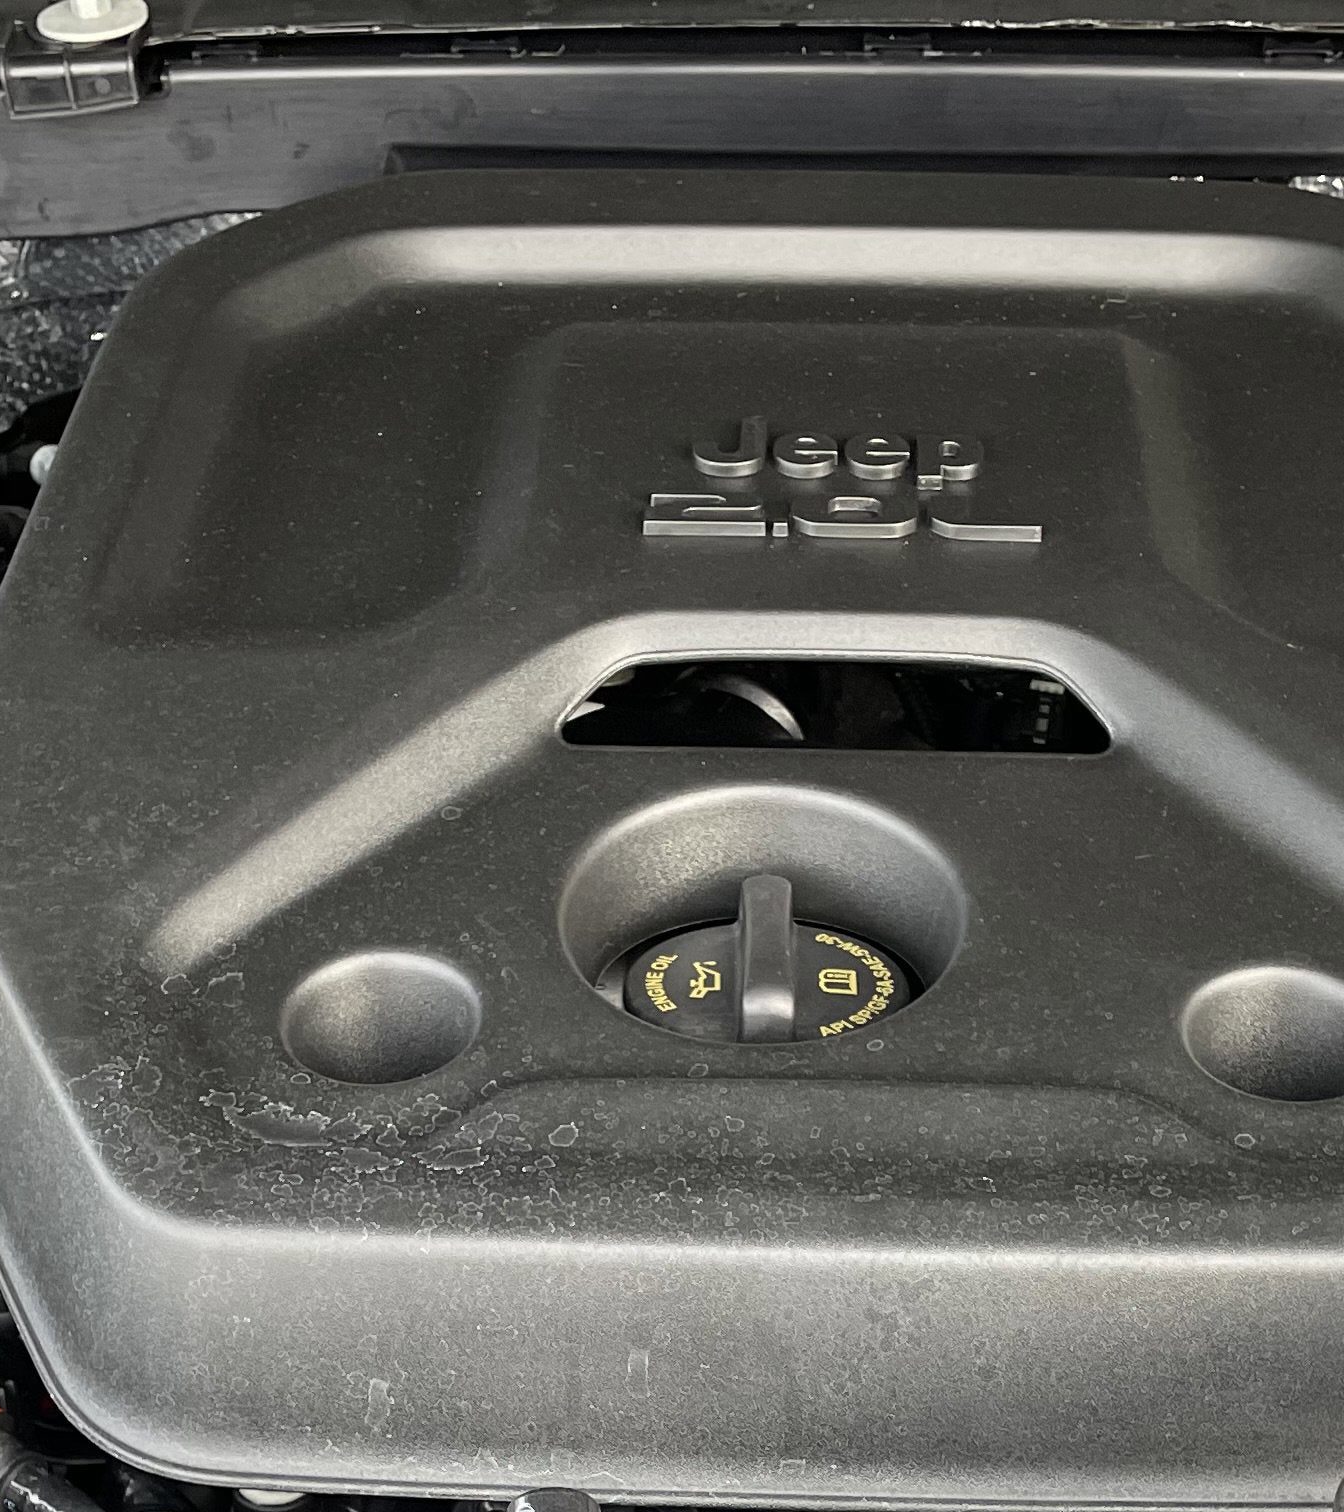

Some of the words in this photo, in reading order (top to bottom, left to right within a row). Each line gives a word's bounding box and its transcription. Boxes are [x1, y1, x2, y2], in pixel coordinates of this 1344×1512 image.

[692, 415, 985, 491] Jeep
[642, 493, 1043, 543] 2.0L
[650, 954, 679, 970] OIL
[645, 971, 678, 1012] ENGINE
[819, 1019, 855, 1037] API
